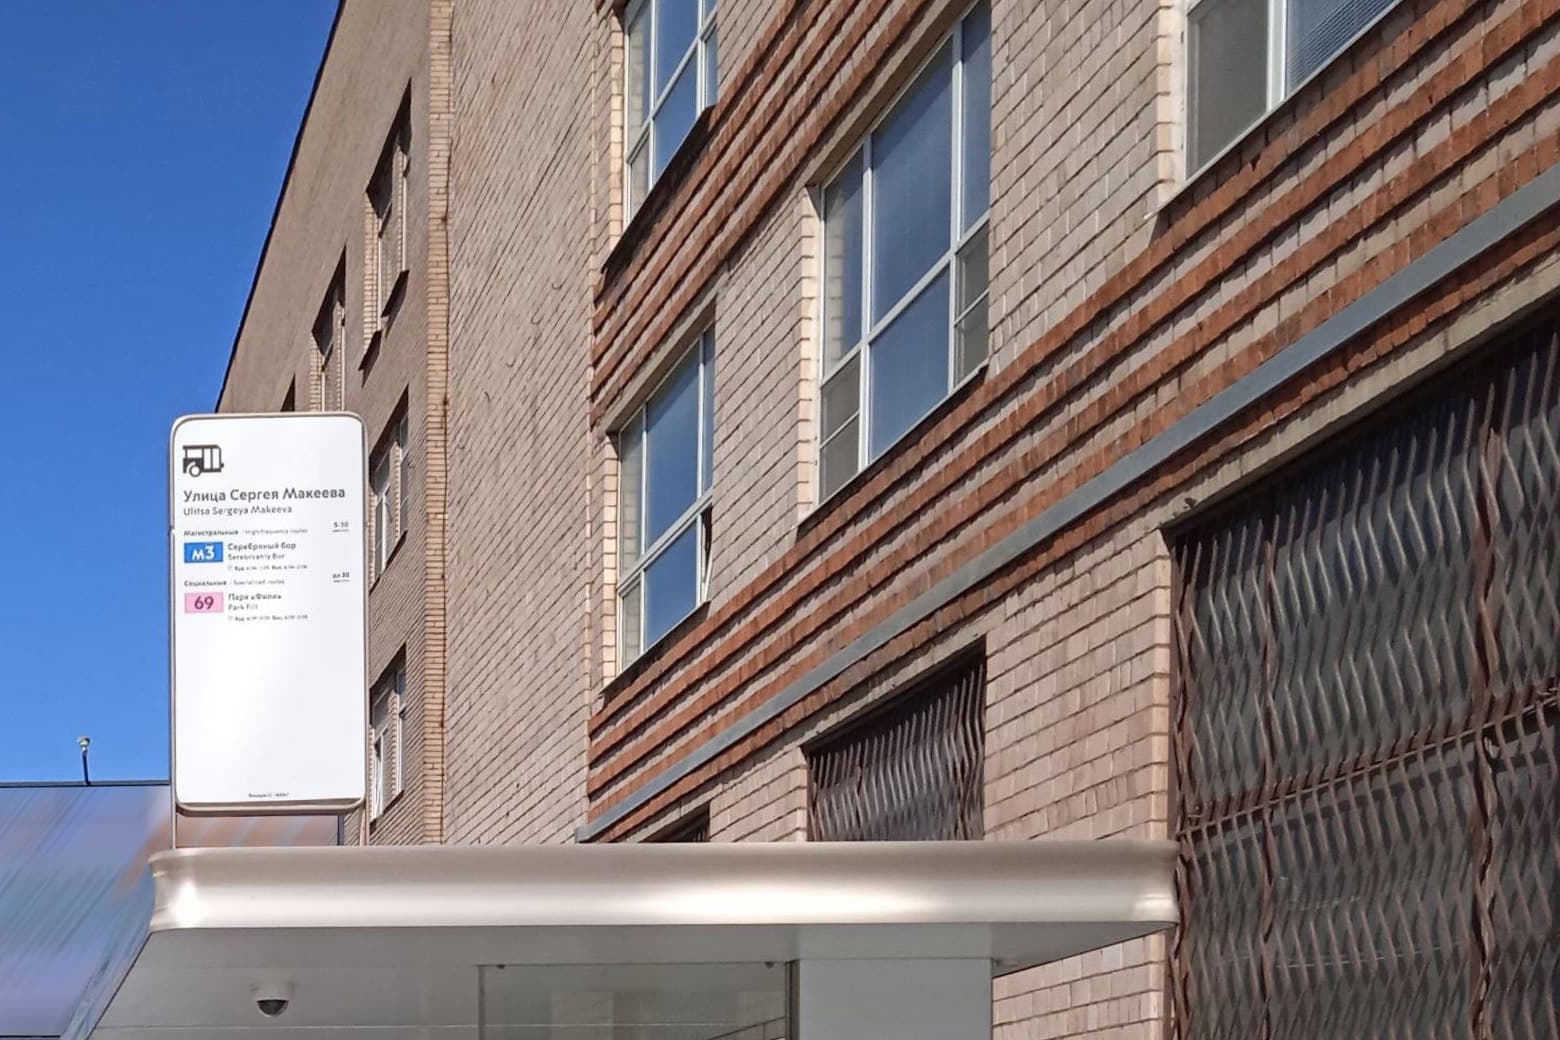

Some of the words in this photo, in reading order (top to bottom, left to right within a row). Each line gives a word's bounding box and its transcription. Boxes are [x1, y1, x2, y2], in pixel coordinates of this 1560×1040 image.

[183, 490, 226, 503] Улица
[230, 489, 279, 503] Сергея
[283, 487, 346, 500] Макеева
[183, 507, 210, 516] Ulitsa
[212, 505, 248, 516] Sergeya
[251, 504, 293, 514] Makeeva
[194, 595, 214, 610] 69
